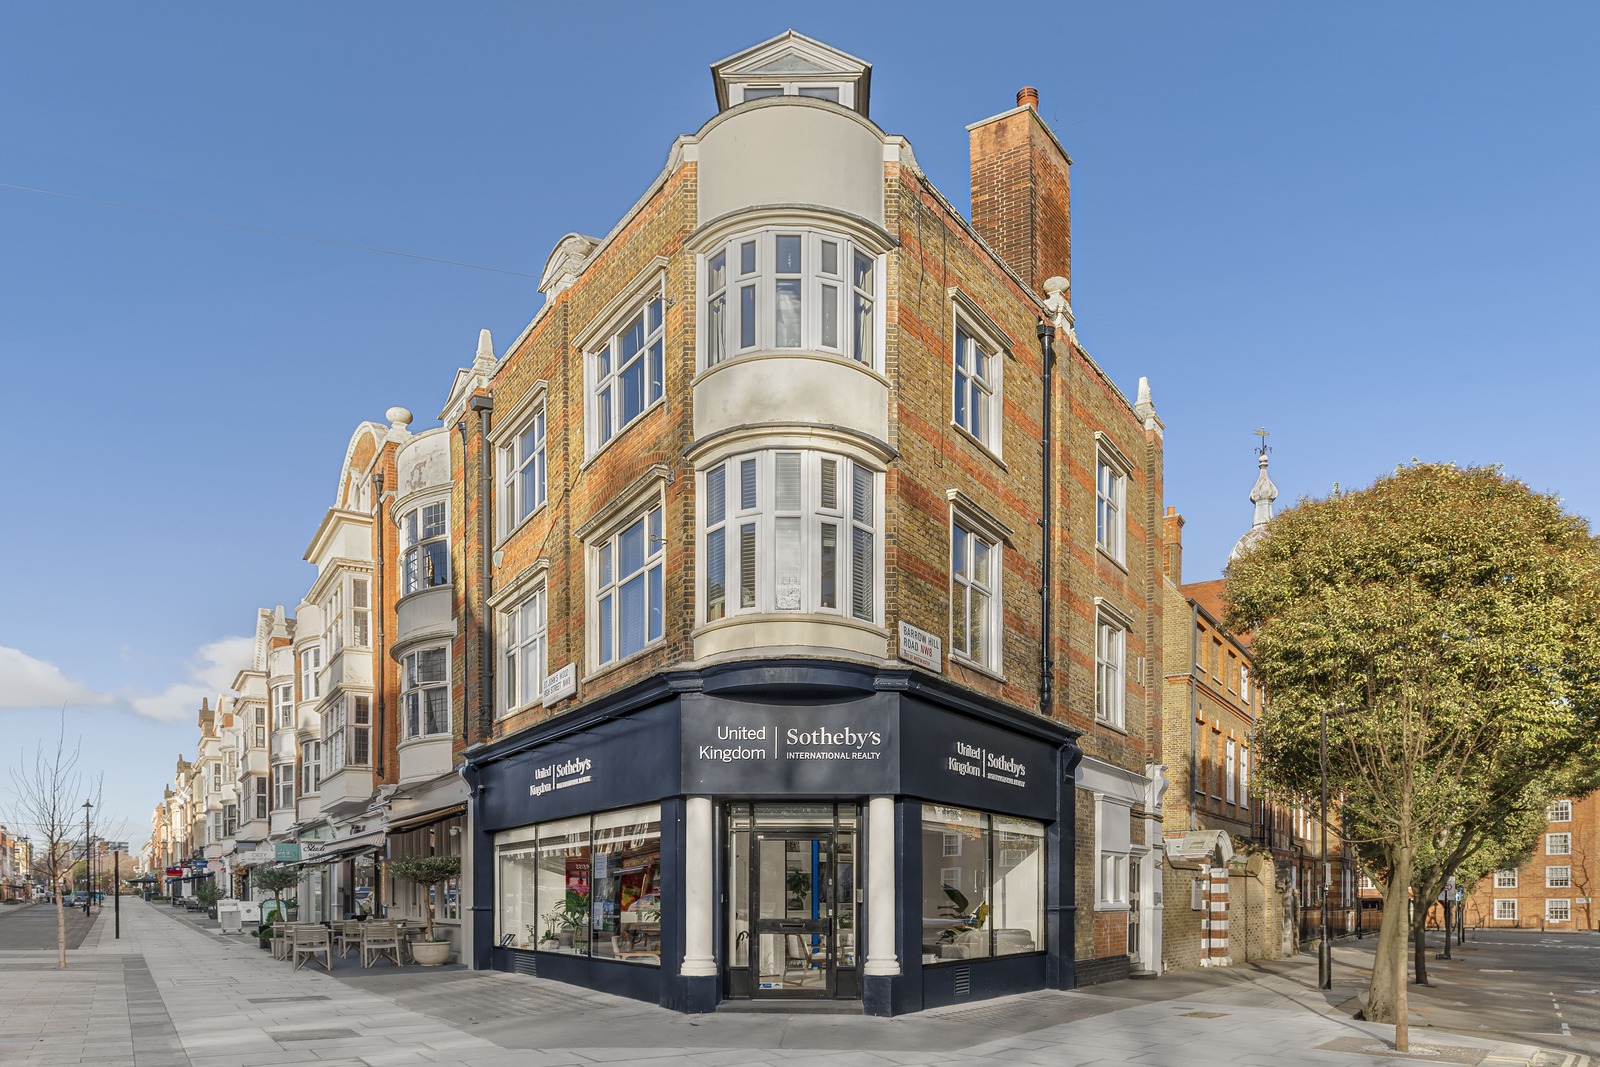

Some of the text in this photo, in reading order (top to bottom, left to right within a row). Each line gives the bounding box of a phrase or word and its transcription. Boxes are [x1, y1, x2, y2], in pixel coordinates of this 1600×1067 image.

[903, 625, 939, 650] BARROW HILL
[903, 637, 933, 658] ROAD NW8
[717, 726, 766, 740] United
[786, 726, 881, 750] Sotheby's
[699, 745, 766, 762] Kingdom
[786, 752, 881, 760] INTERNATIONAL REALTY
[956, 741, 981, 760] United
[535, 765, 551, 780] United
[556, 757, 591, 778] Sotheby's
[948, 757, 981, 776] Kingdom
[987, 753, 1026, 778] Sotheby's
[303, 843, 326, 852] Studi
